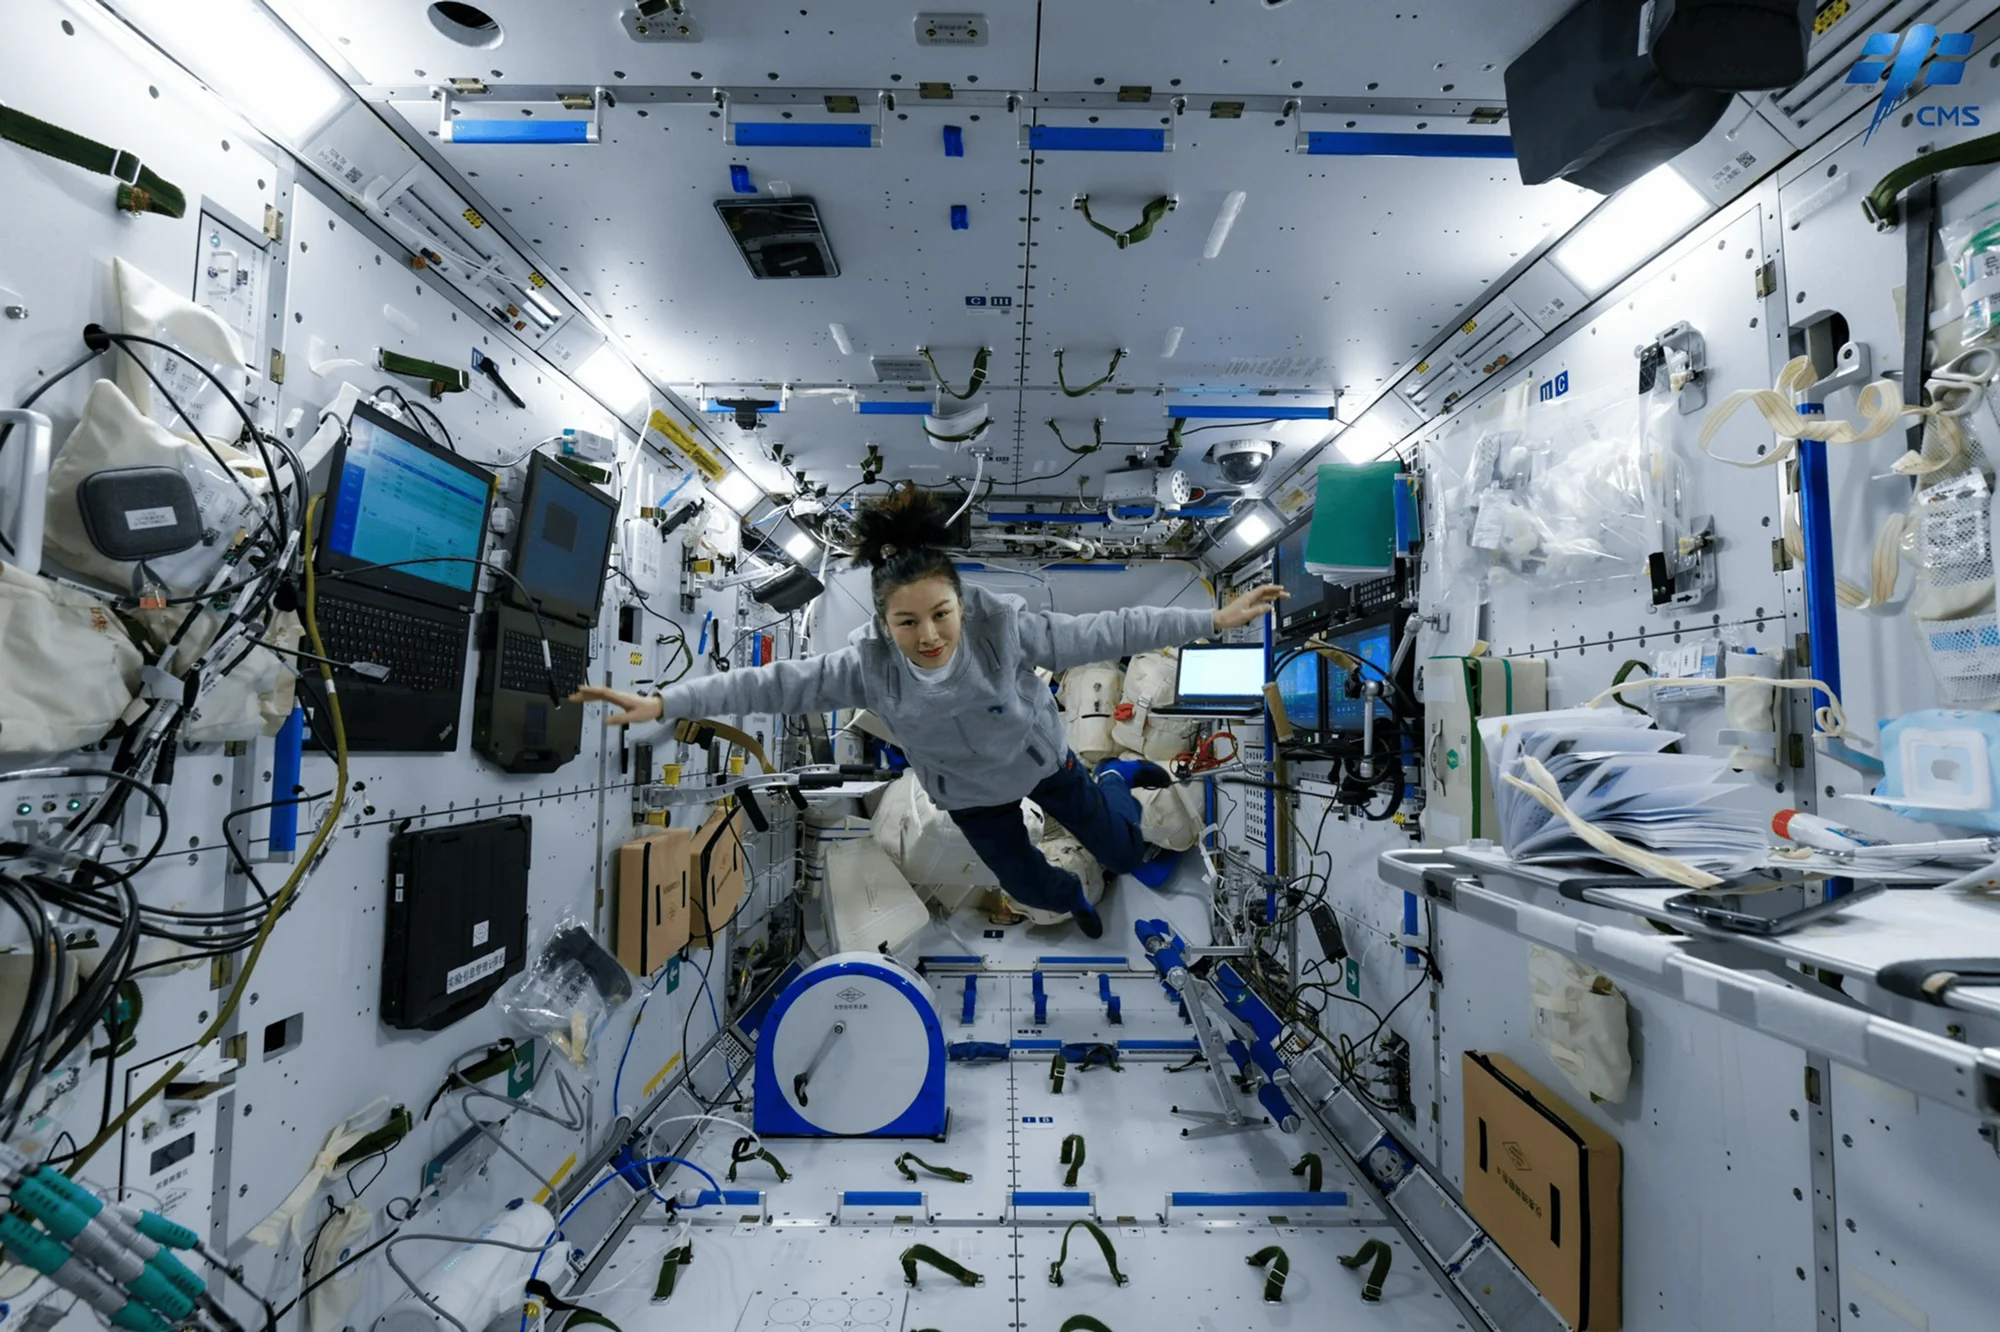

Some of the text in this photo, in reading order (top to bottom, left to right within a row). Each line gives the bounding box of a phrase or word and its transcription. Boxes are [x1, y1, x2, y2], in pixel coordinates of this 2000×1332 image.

[970, 297, 1009, 305] C III
[1558, 376, 1566, 392] C
